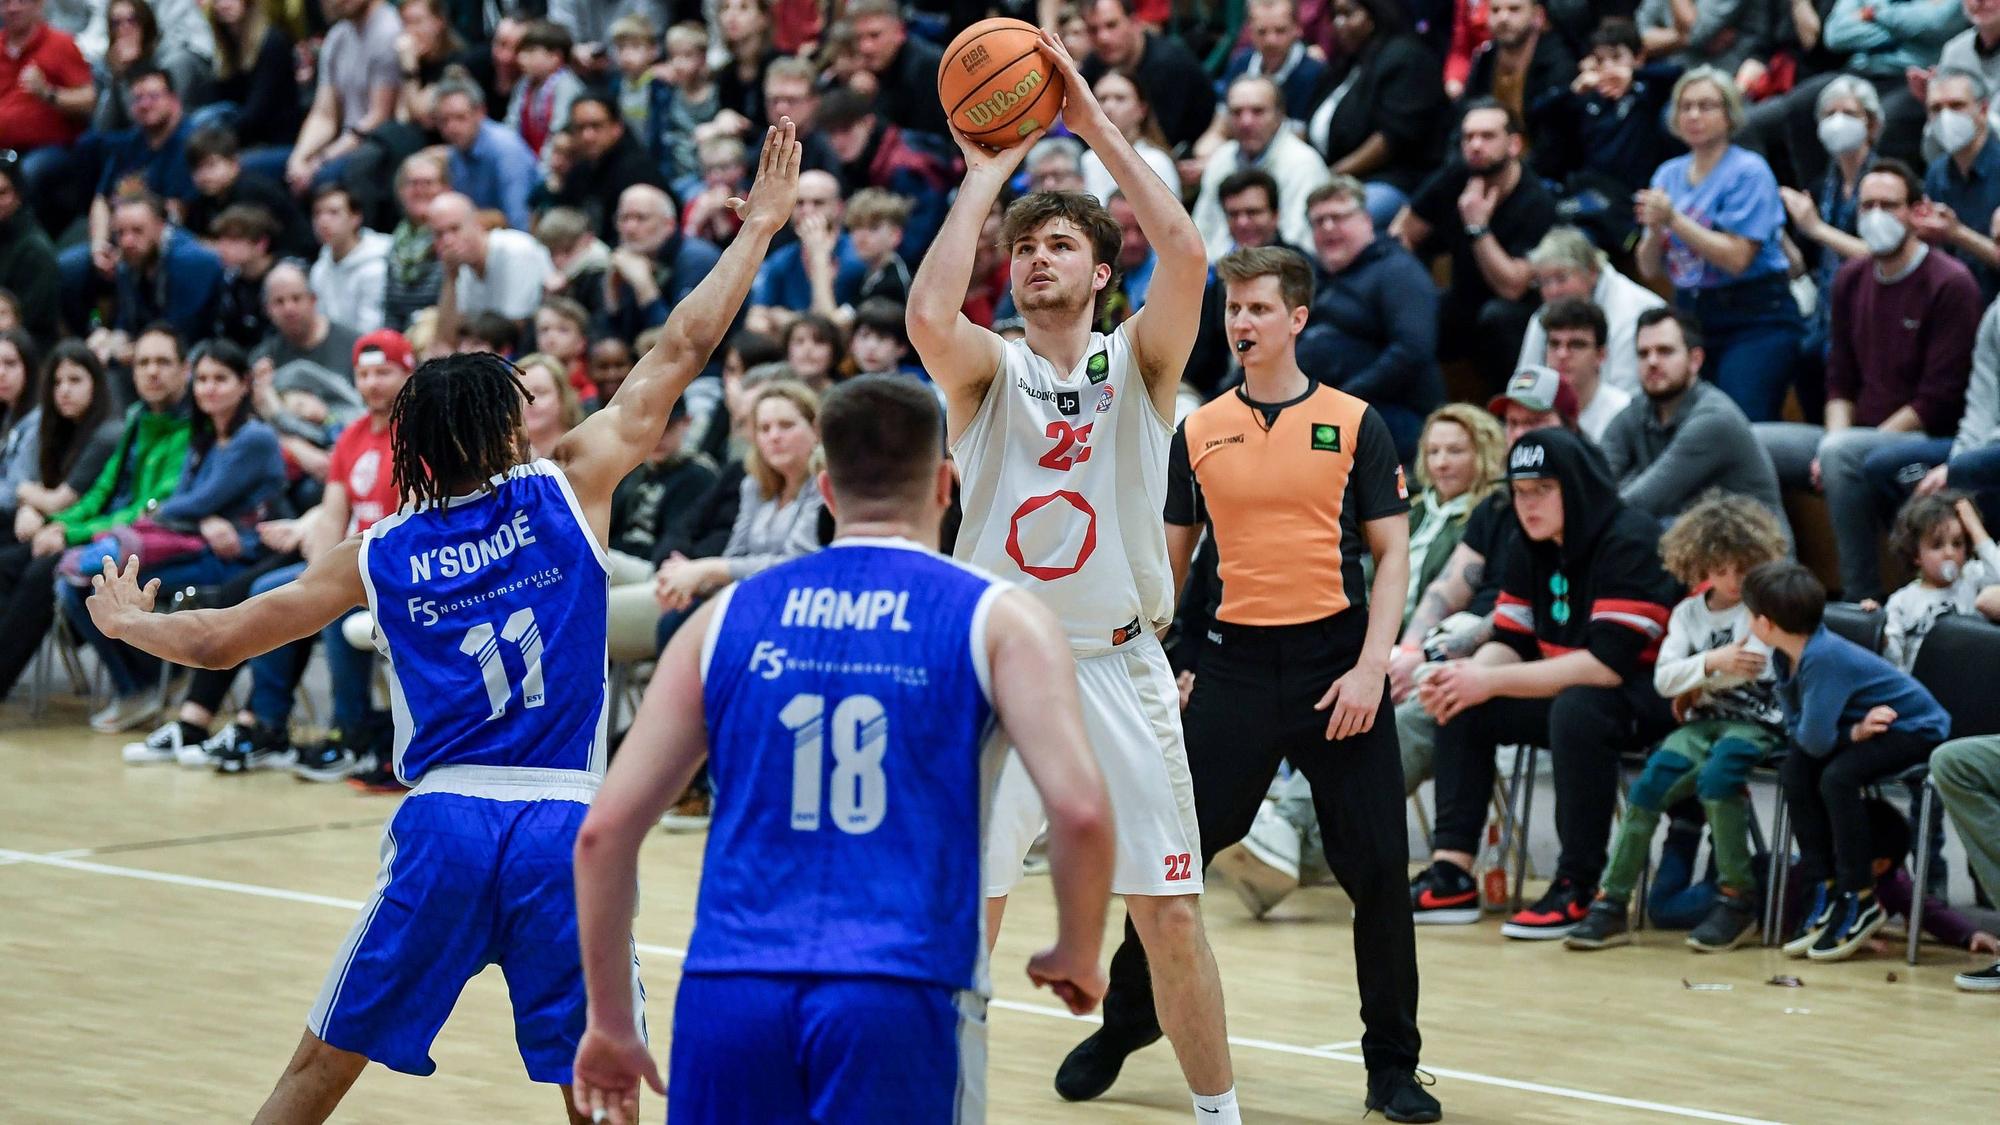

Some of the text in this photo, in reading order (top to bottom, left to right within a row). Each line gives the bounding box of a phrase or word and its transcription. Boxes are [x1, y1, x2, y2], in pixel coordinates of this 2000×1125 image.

[961, 45, 987, 67] FIBA
[965, 69, 1042, 127] Wilson
[1018, 377, 1056, 403] SPALDING
[407, 566, 559, 627] FS Notstromservice
[781, 587, 912, 632] HAMPL
[459, 607, 545, 721] 11
[748, 641, 788, 680] FS
[778, 693, 888, 835] 18
[1164, 853, 1191, 881] 22
